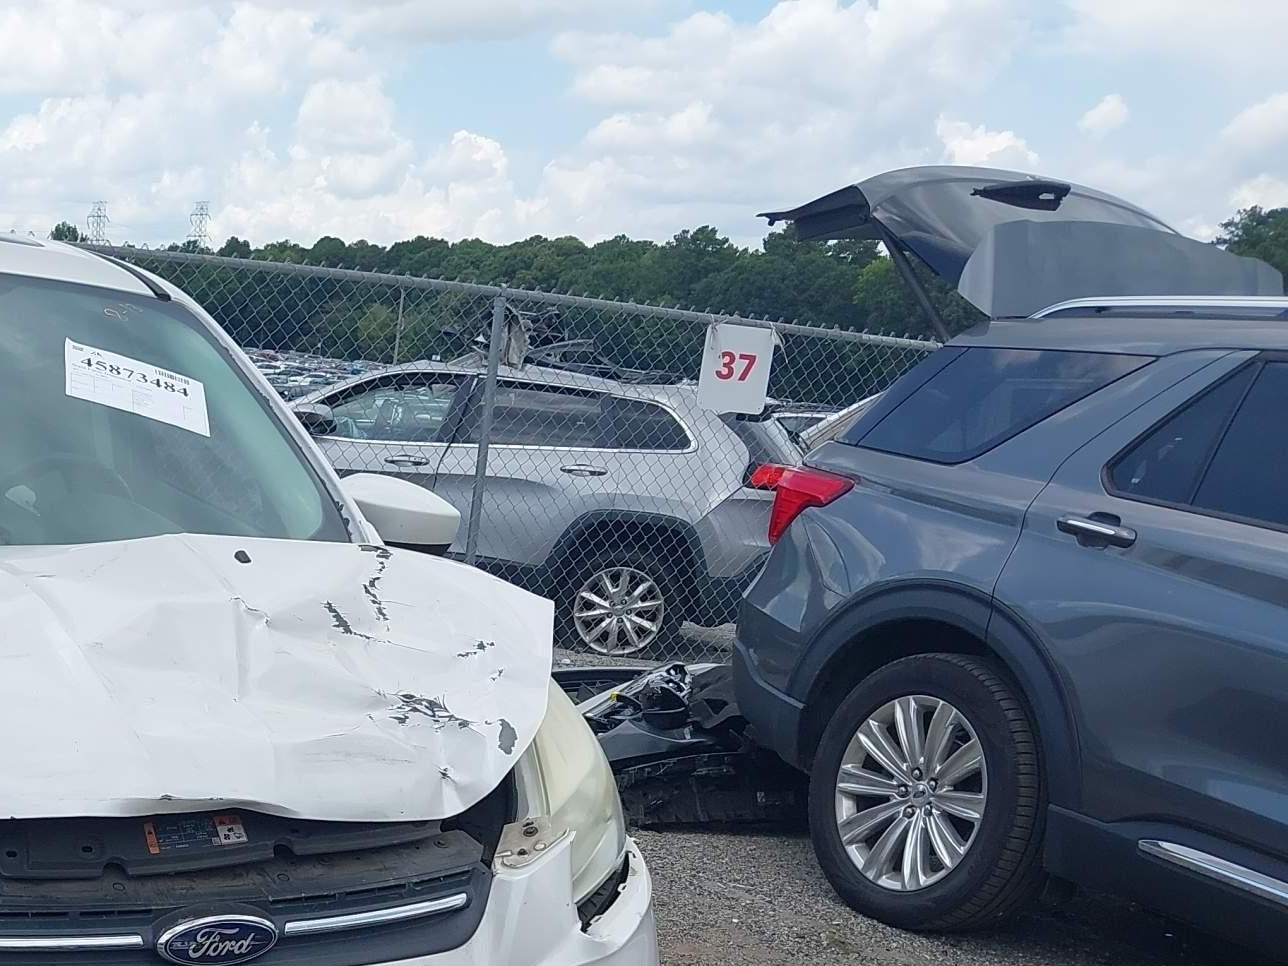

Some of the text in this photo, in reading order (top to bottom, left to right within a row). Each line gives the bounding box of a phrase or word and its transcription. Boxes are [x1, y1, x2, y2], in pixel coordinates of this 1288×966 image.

[80, 357, 190, 398] 45873484
[715, 350, 758, 382] 37
[189, 927, 255, 959] Ford
